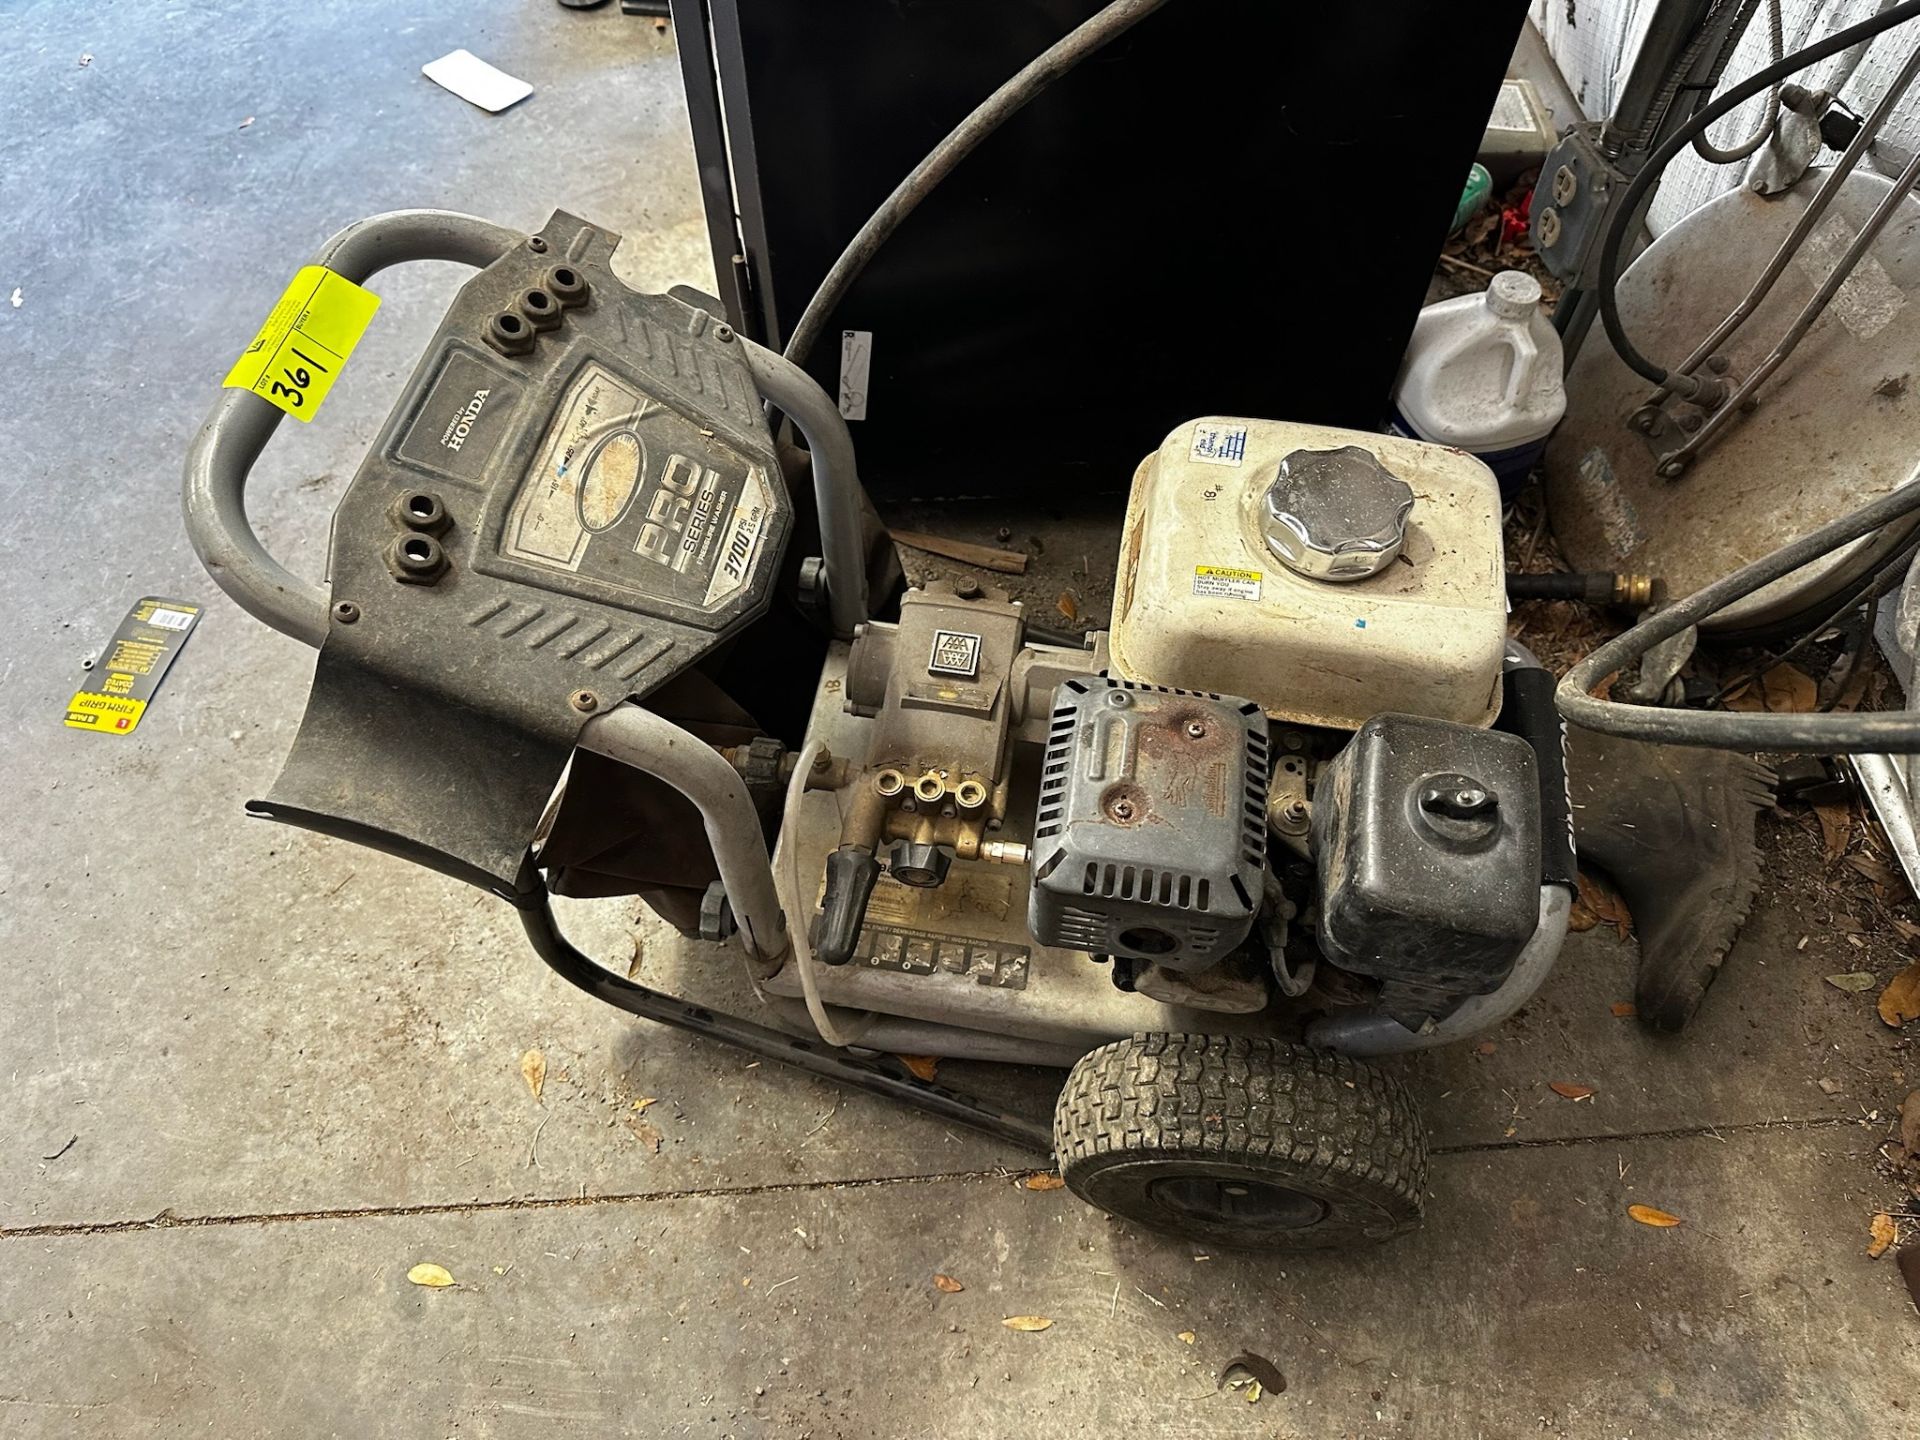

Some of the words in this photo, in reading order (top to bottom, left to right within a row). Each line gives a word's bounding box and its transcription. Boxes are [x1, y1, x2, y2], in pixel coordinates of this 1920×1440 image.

[296, 313, 309, 330] BUYER
[844, 331, 855, 339] R
[258, 378, 268, 390] LOT
[271, 347, 328, 407] 361
[440, 413, 461, 446] POWERED
[458, 406, 466, 416] by
[447, 389, 490, 452] HONDA
[632, 453, 702, 566] PRO
[750, 506, 761, 522] GPM
[683, 489, 714, 553] SERIES
[696, 525, 714, 566] PRESSURE
[711, 490, 728, 526] WASHER
[738, 517, 748, 531] PSI
[746, 522, 756, 534] 2.5
[723, 530, 750, 580] 3700
[1212, 576, 1241, 584] MUFFLER
[1215, 569, 1252, 579] CAUTION
[79, 699, 106, 711] GRIP
[104, 701, 136, 714] FIRM
